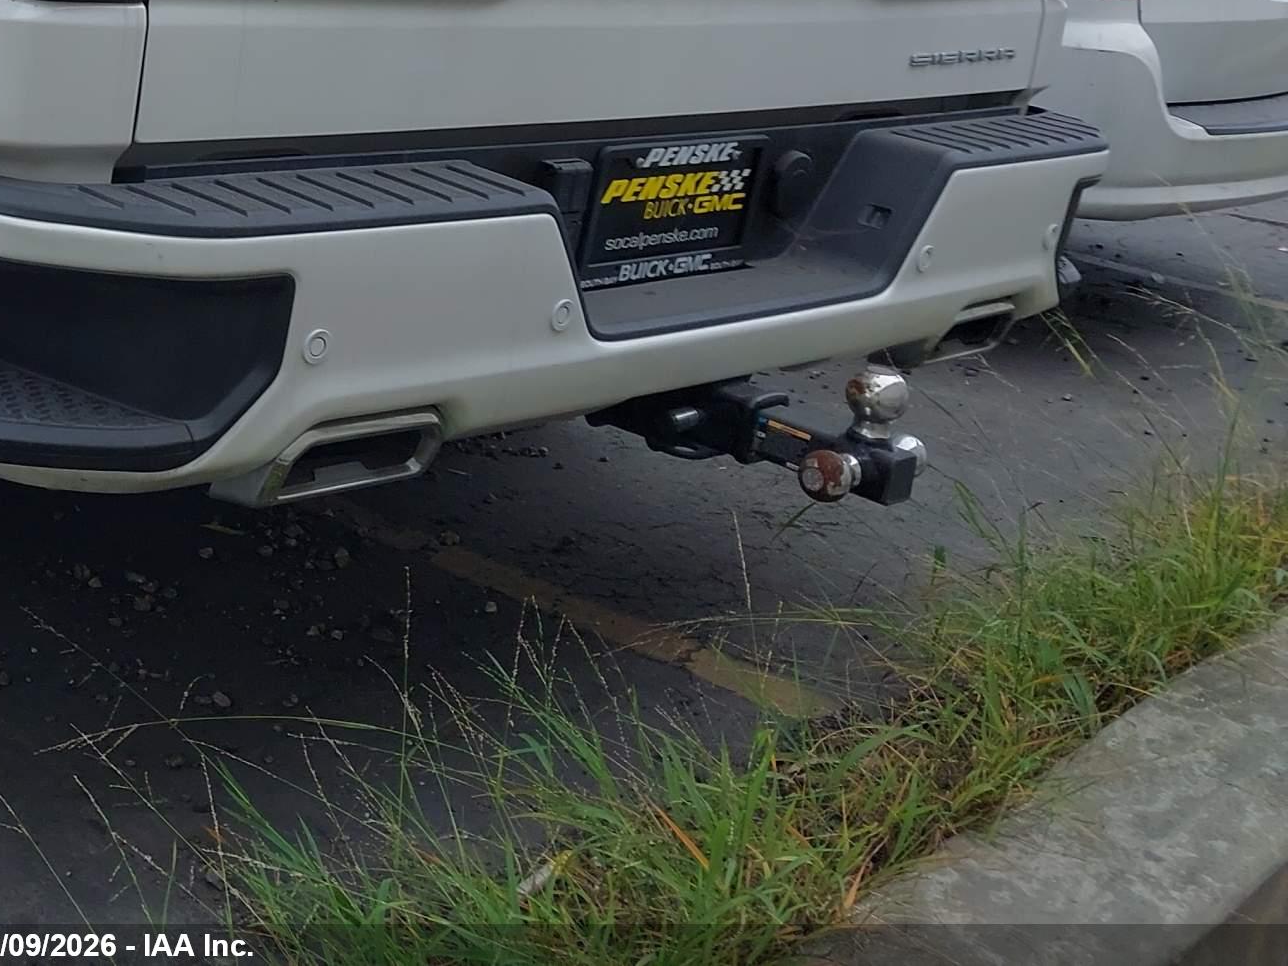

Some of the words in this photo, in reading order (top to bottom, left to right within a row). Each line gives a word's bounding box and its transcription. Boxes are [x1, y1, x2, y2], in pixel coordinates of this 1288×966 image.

[909, 47, 1016, 67] SIERRA
[642, 142, 739, 169] PENSKE
[600, 170, 721, 204] PENSKE
[604, 225, 719, 250] socalpenske.com
